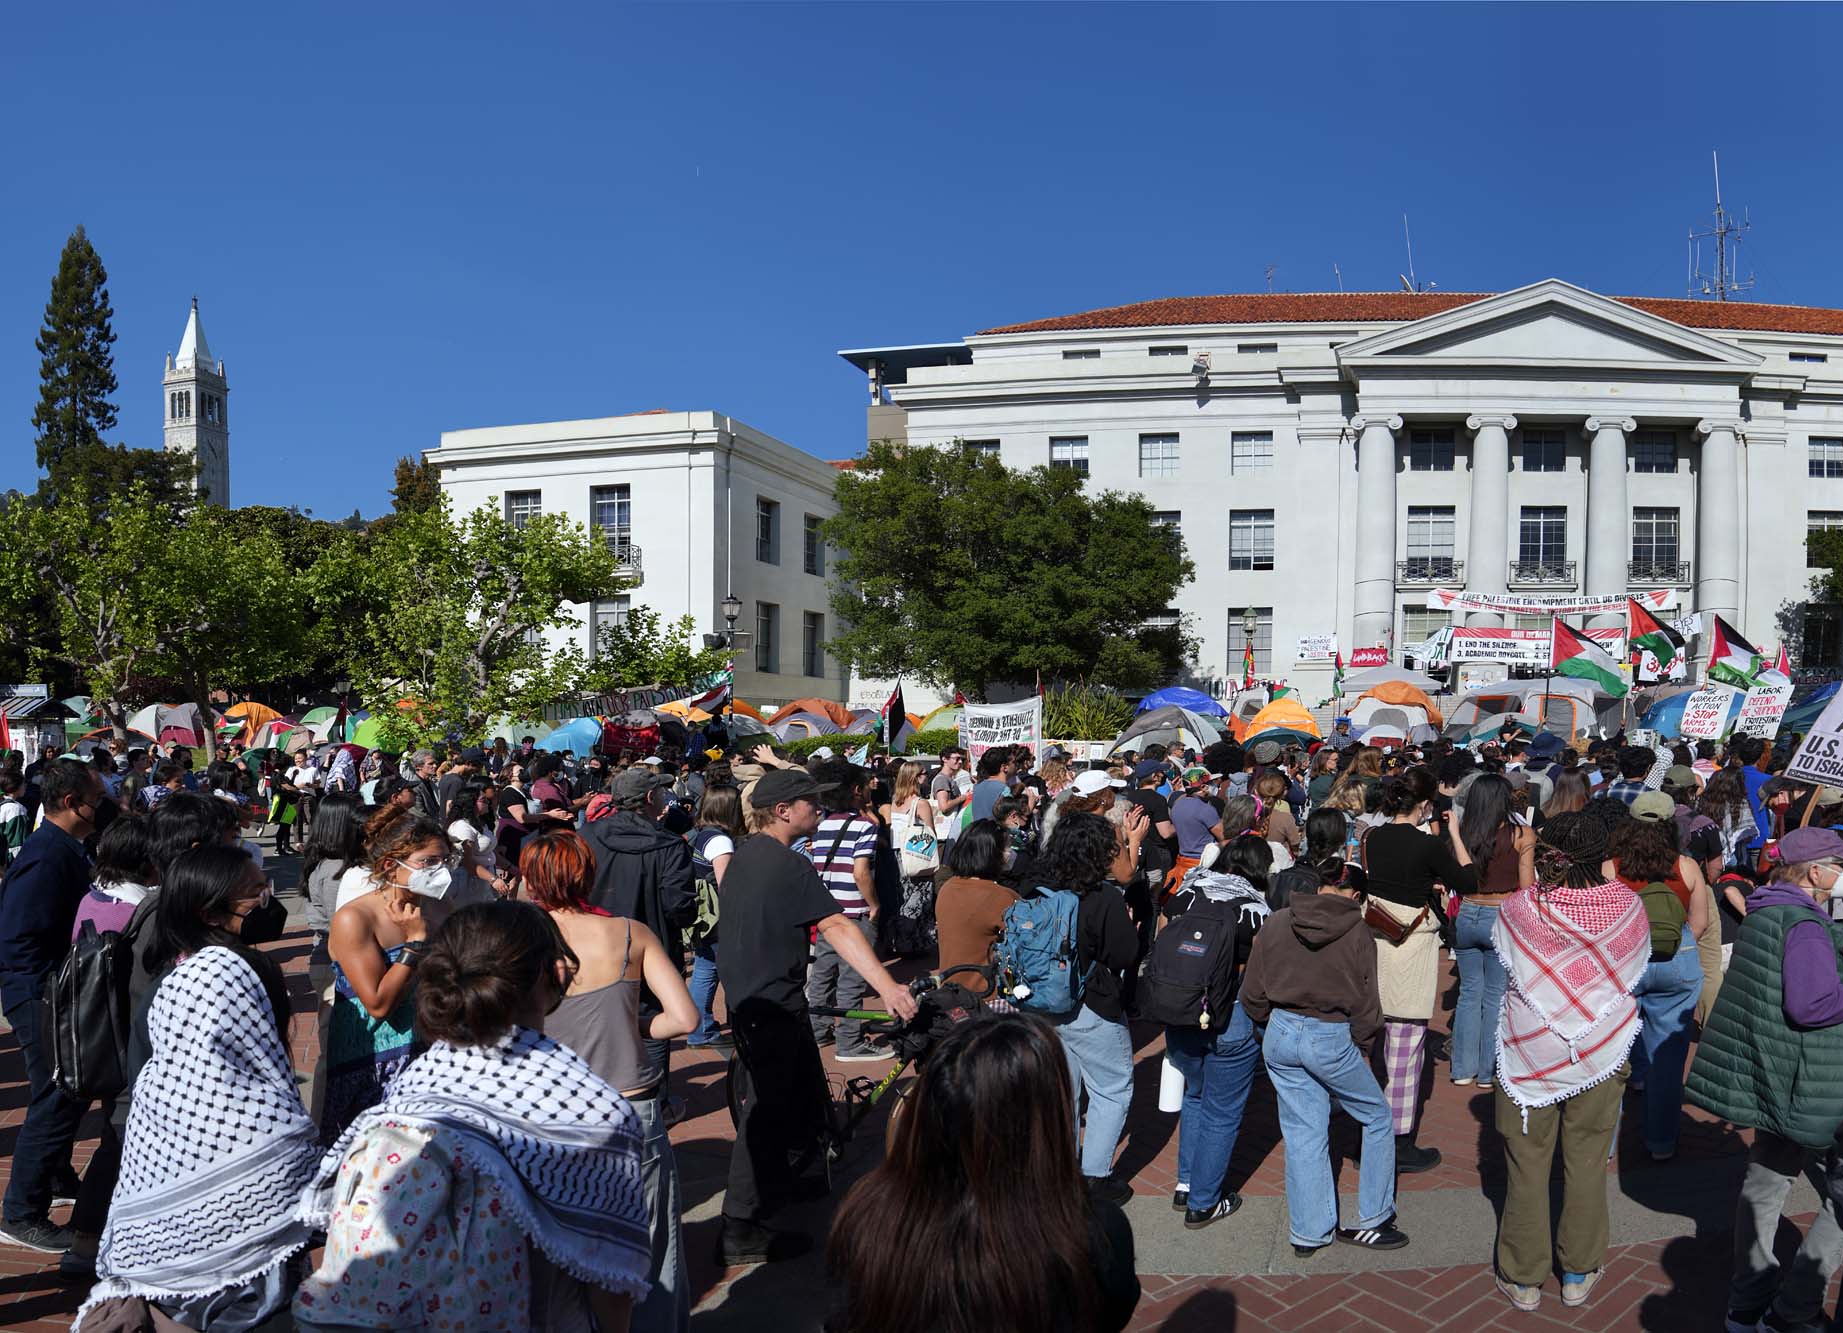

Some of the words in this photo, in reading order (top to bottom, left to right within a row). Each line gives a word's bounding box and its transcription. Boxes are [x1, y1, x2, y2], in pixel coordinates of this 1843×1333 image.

[1526, 630, 1551, 638] DEMAN
[1690, 694, 1730, 703] WORKERS
[1748, 696, 1777, 706] DEFEND
[1691, 702, 1722, 710] ACTION
[1754, 704, 1786, 716] STUDENTS
[1693, 710, 1718, 720] STOP
[1744, 715, 1782, 724] PROTESTING
[1683, 719, 1706, 727] ARMS
[1684, 726, 1717, 735] ISRAEL!
[1805, 735, 1840, 759] U.S.
[1796, 754, 1816, 770] TO
